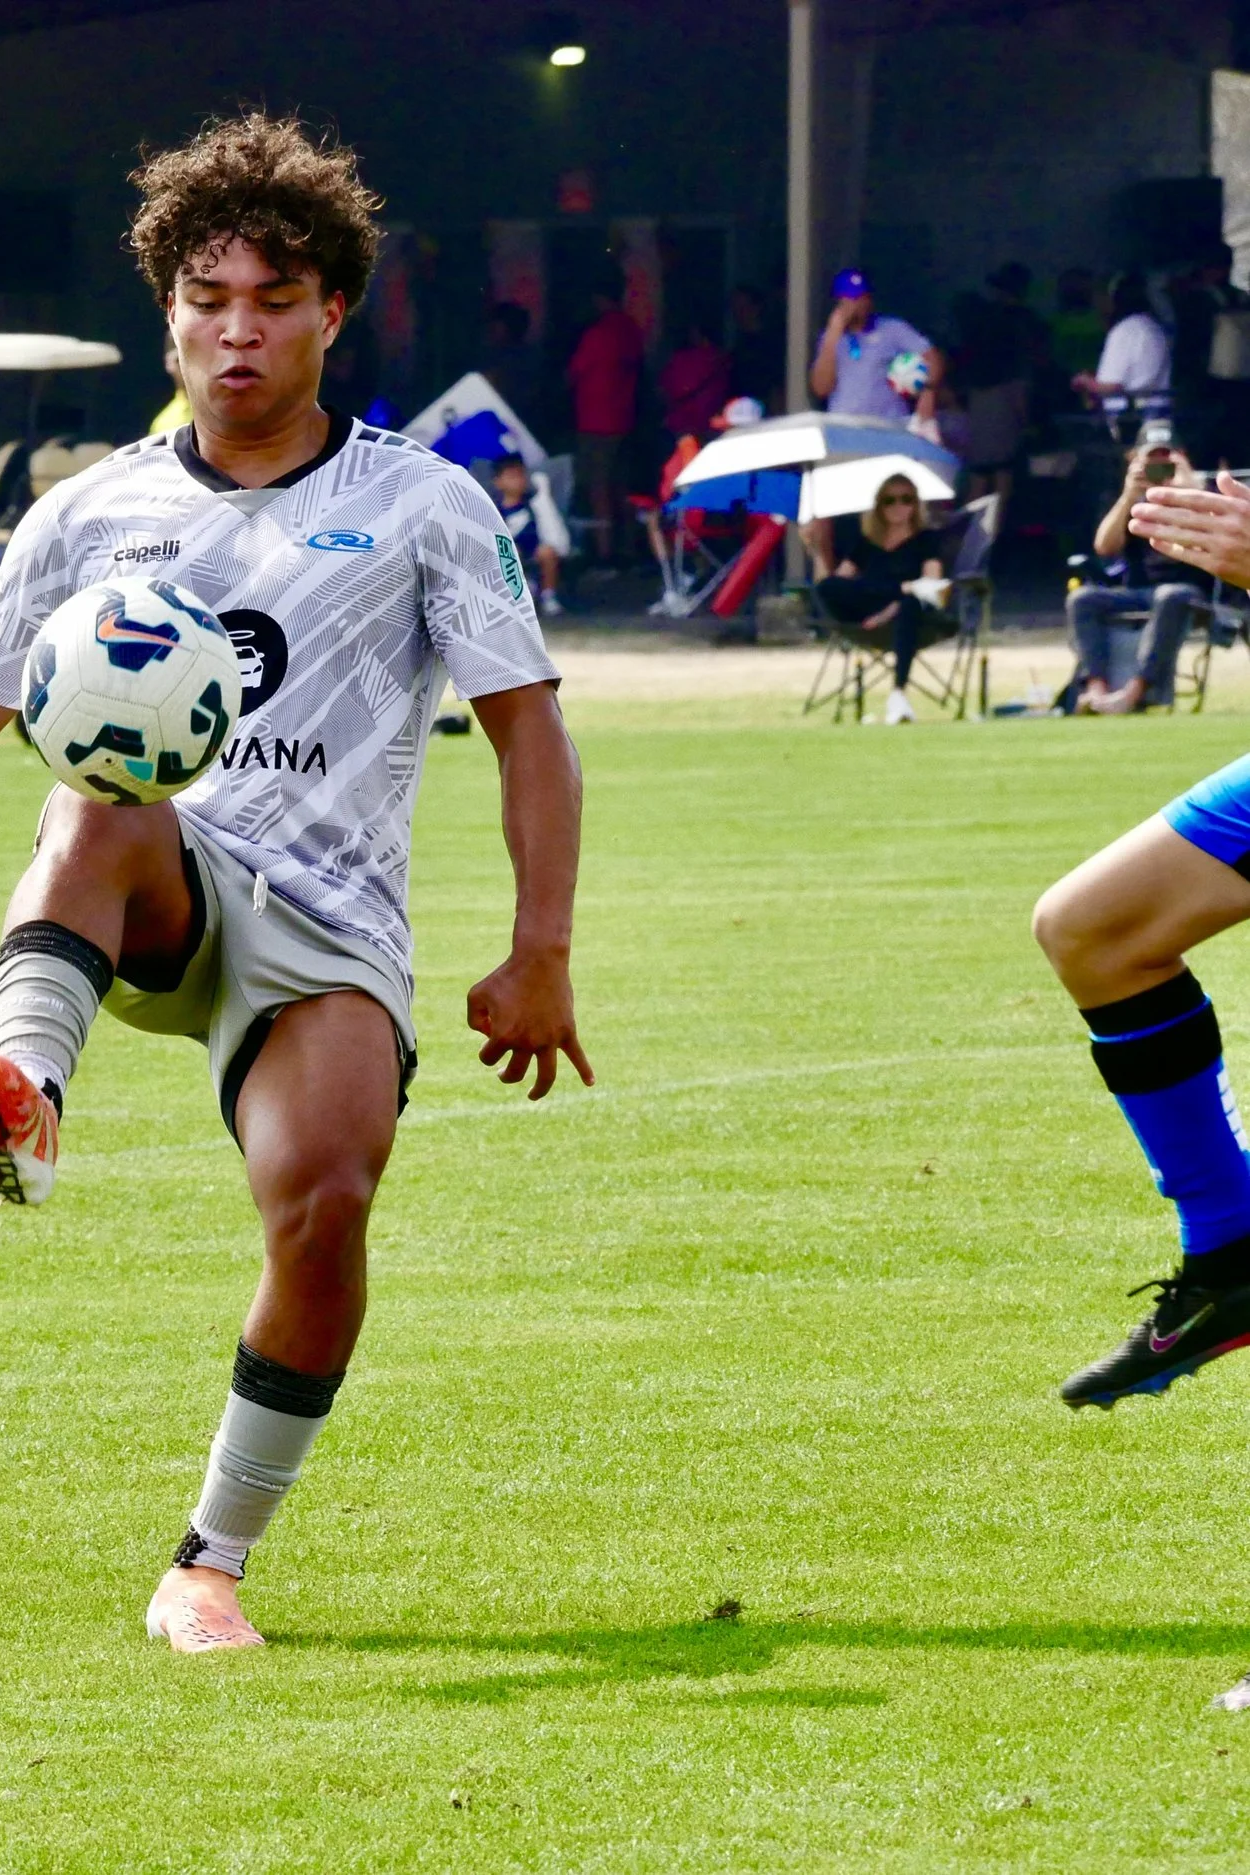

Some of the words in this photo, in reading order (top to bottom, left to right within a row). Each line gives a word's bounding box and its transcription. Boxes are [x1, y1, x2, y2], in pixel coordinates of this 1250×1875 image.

[113, 539, 181, 563] capelli
[141, 555, 178, 564] SPORT
[220, 736, 327, 777] VANA
